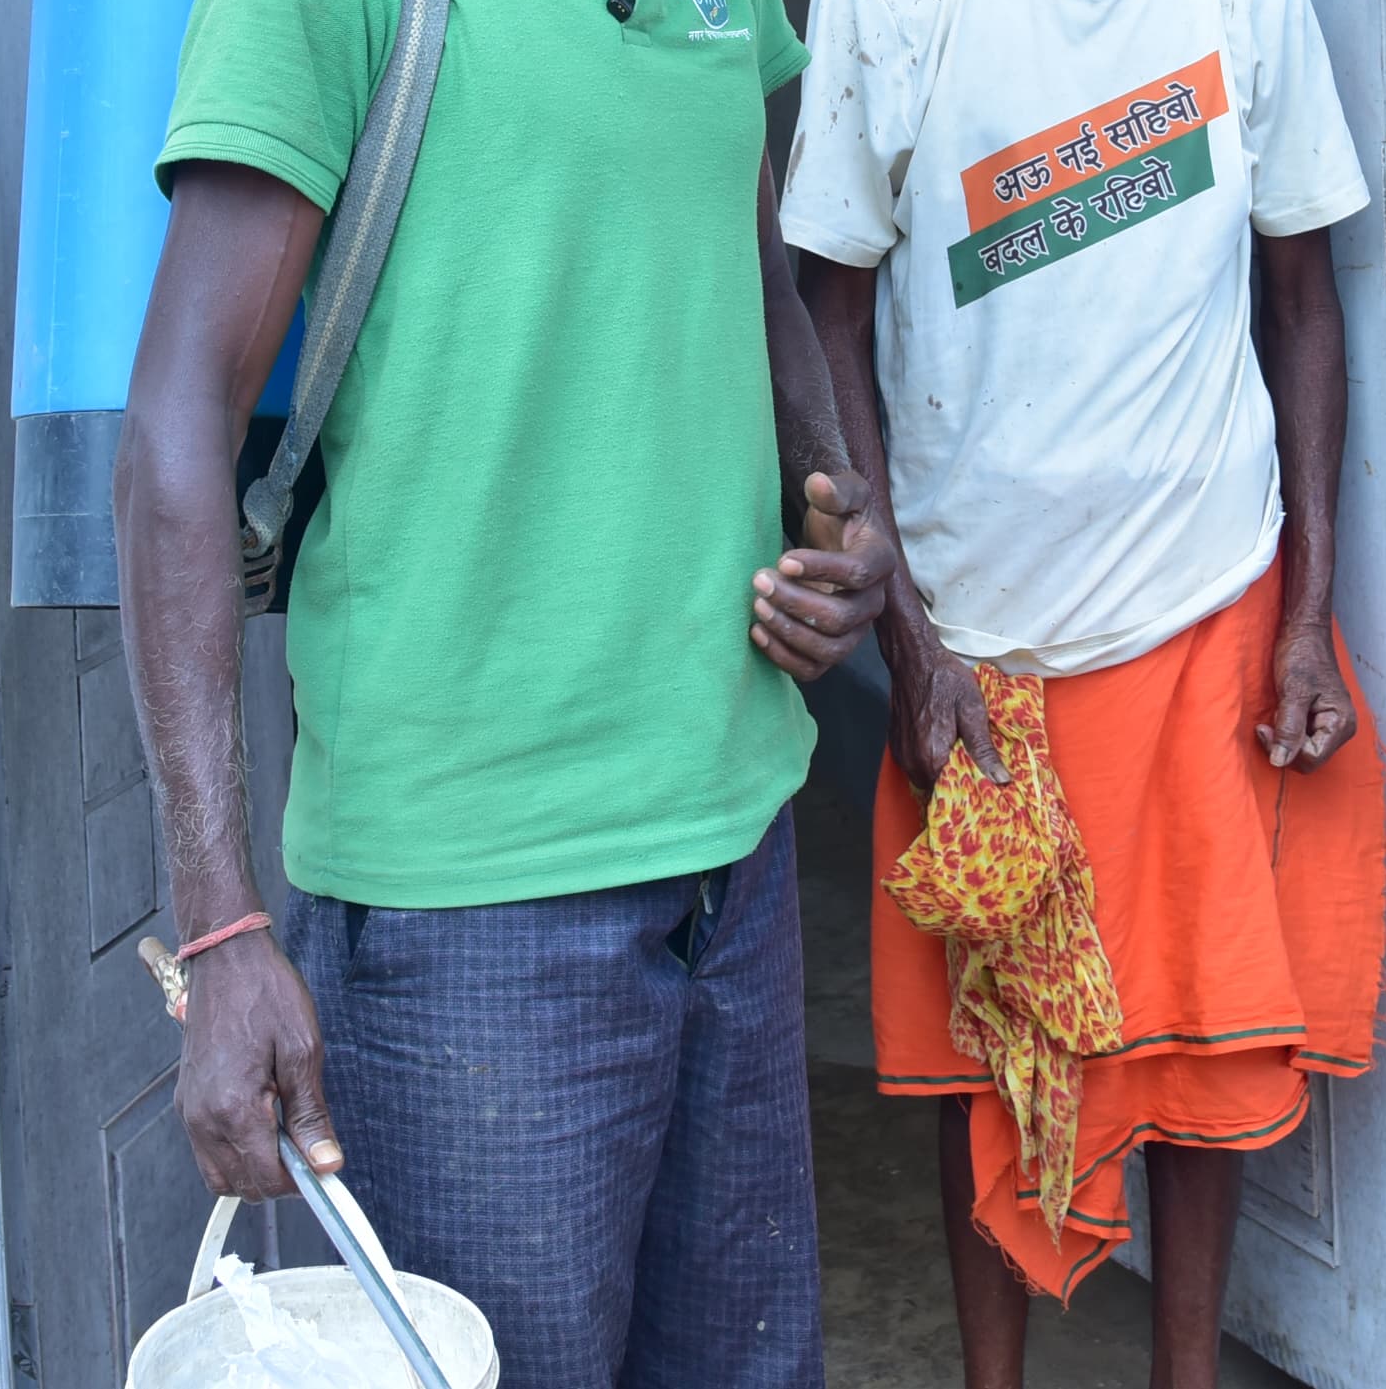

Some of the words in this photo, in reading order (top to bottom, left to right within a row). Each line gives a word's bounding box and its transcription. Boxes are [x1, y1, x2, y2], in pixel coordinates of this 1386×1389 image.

[993, 155, 1051, 203] अऊ
[1056, 123, 1103, 175] नई
[1103, 82, 1200, 153] सहिबो
[979, 220, 1049, 276] बदल
[1051, 197, 1086, 240] के
[1090, 158, 1177, 223] रहिबो
